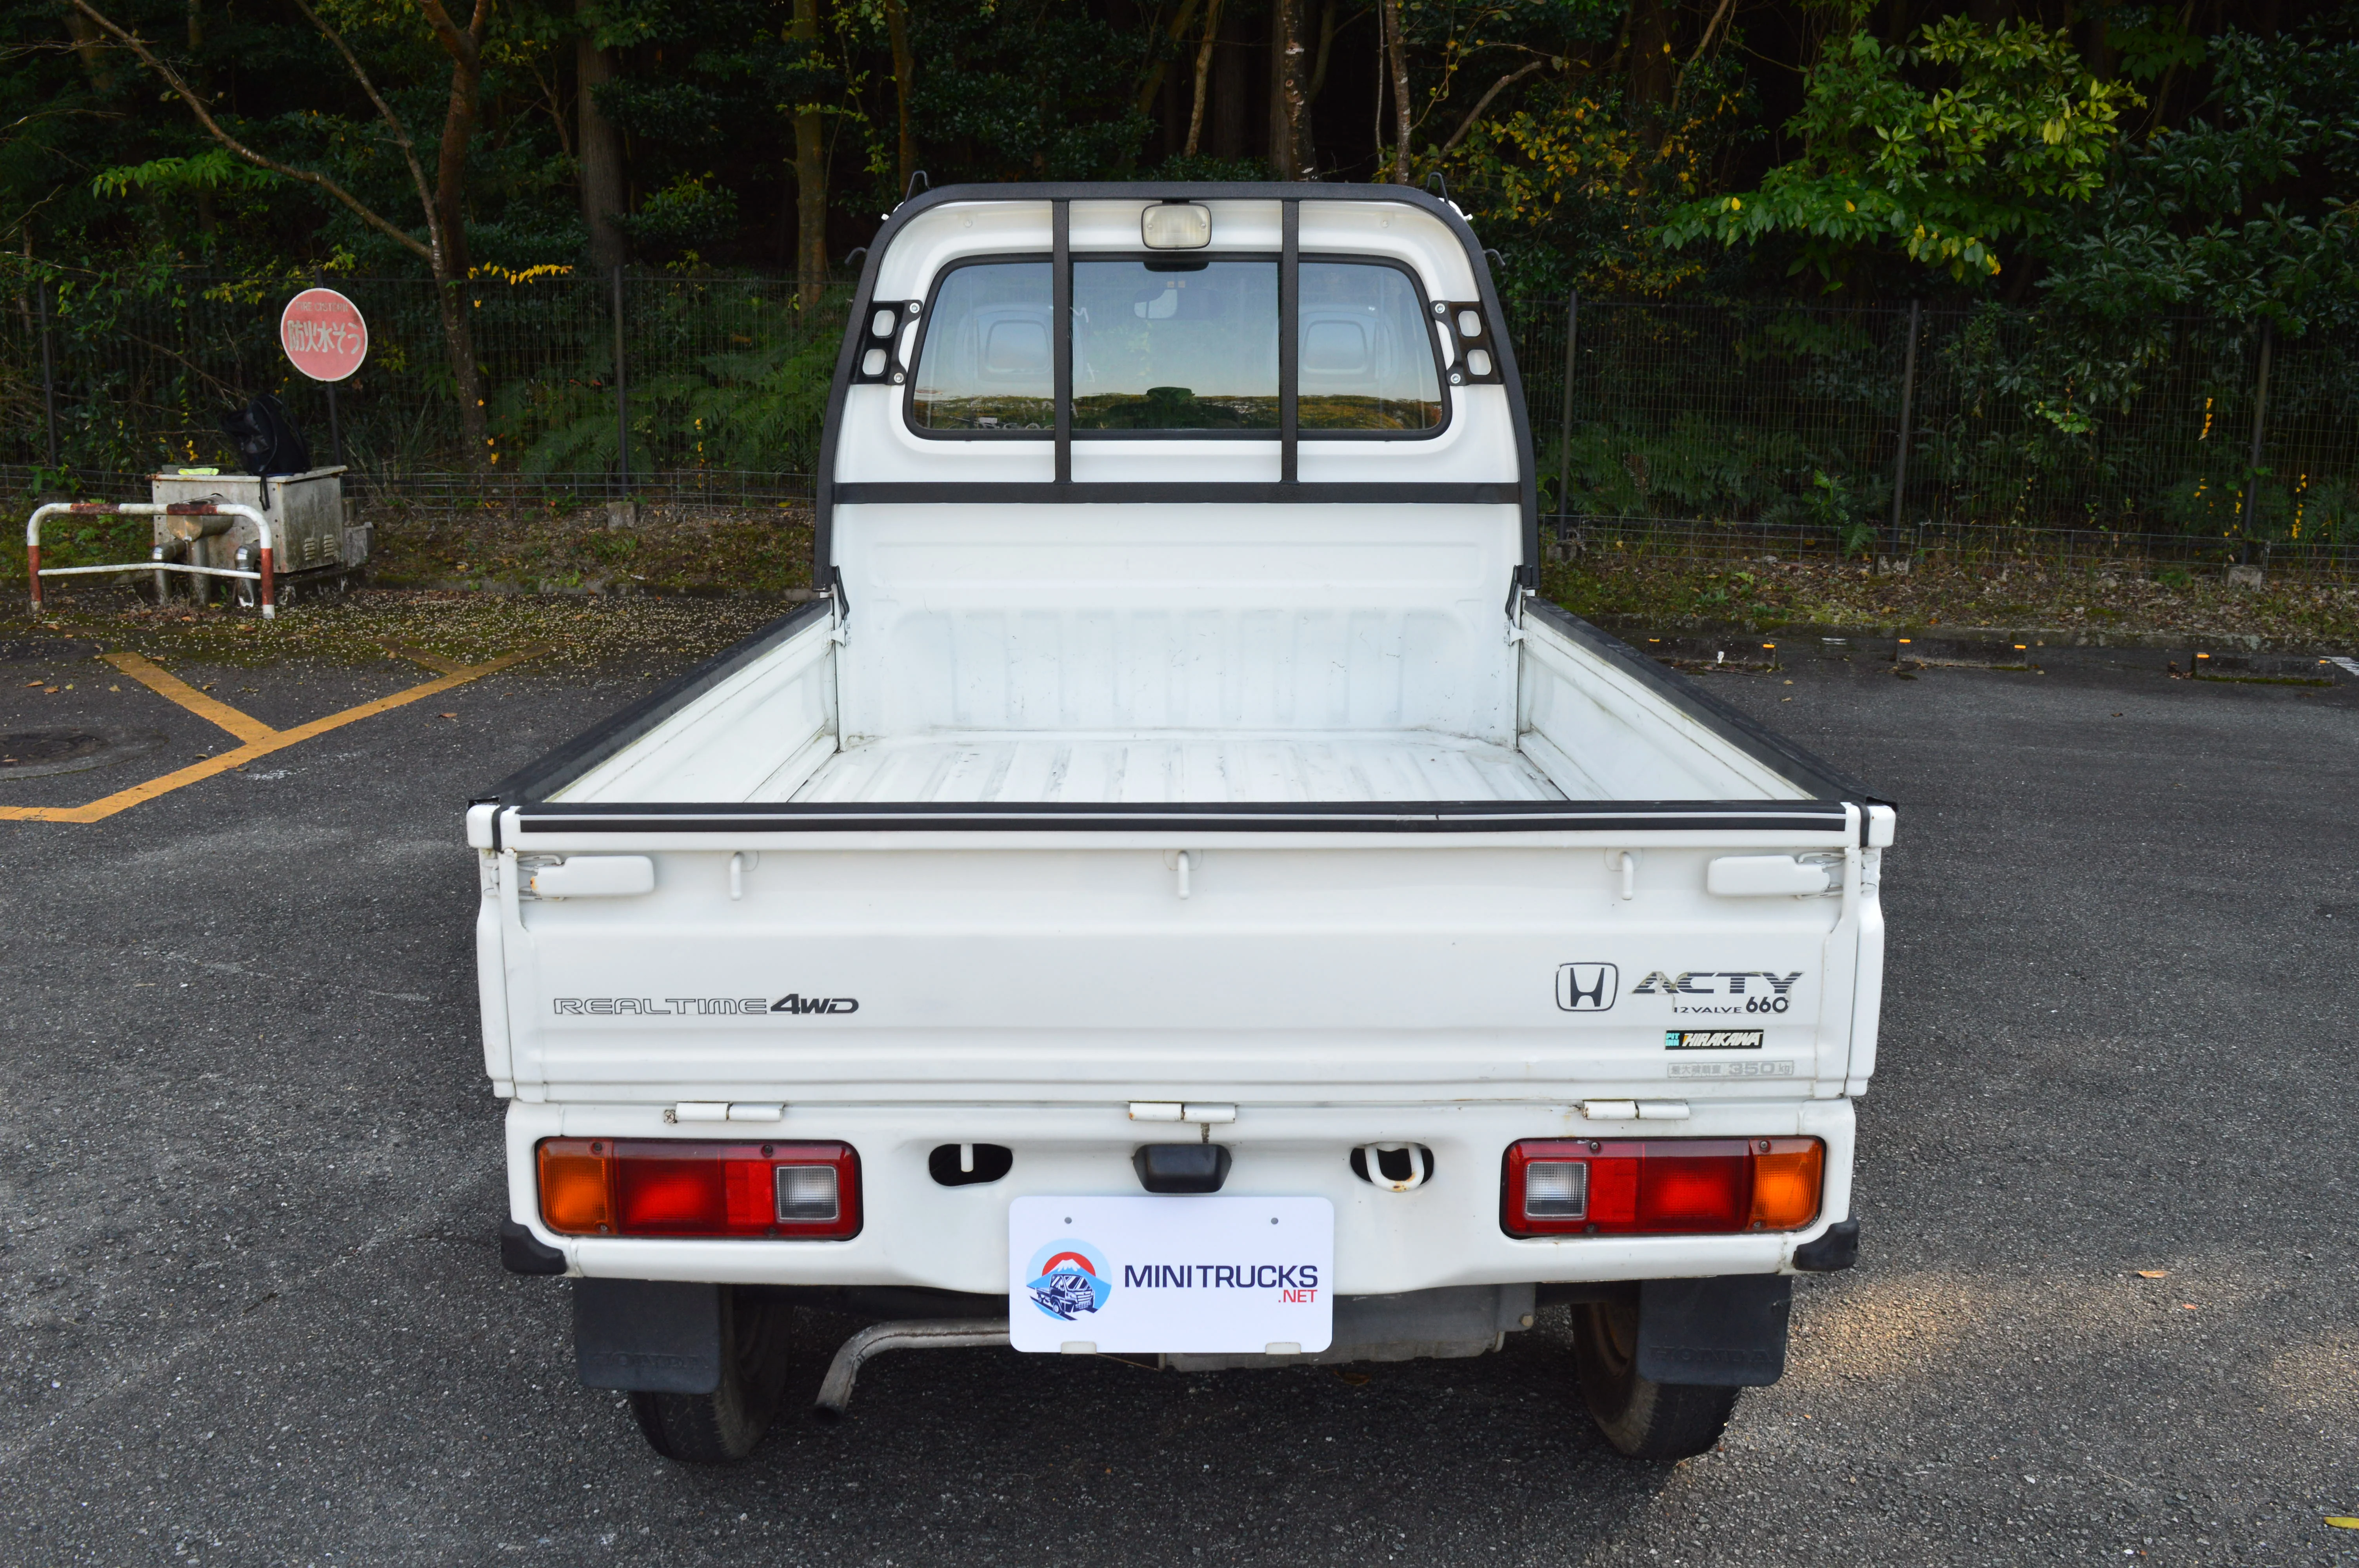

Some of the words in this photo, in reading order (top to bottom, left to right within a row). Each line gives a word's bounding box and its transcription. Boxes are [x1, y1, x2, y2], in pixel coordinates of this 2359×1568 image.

[296, 301, 313, 311] FIRE
[314, 302, 348, 312] CISTERN
[287, 319, 361, 354] 防火水そう
[1631, 971, 1805, 994] ACTY
[554, 998, 768, 1014] REALTIME
[771, 994, 860, 1014] 4WD
[1745, 996, 1789, 1013] 660
[1682, 1032, 1763, 1047] HIRAKAWA
[1728, 1062, 1775, 1075] 350
[1779, 1063, 1790, 1073] kg
[1278, 1289, 1318, 1303] .NET
